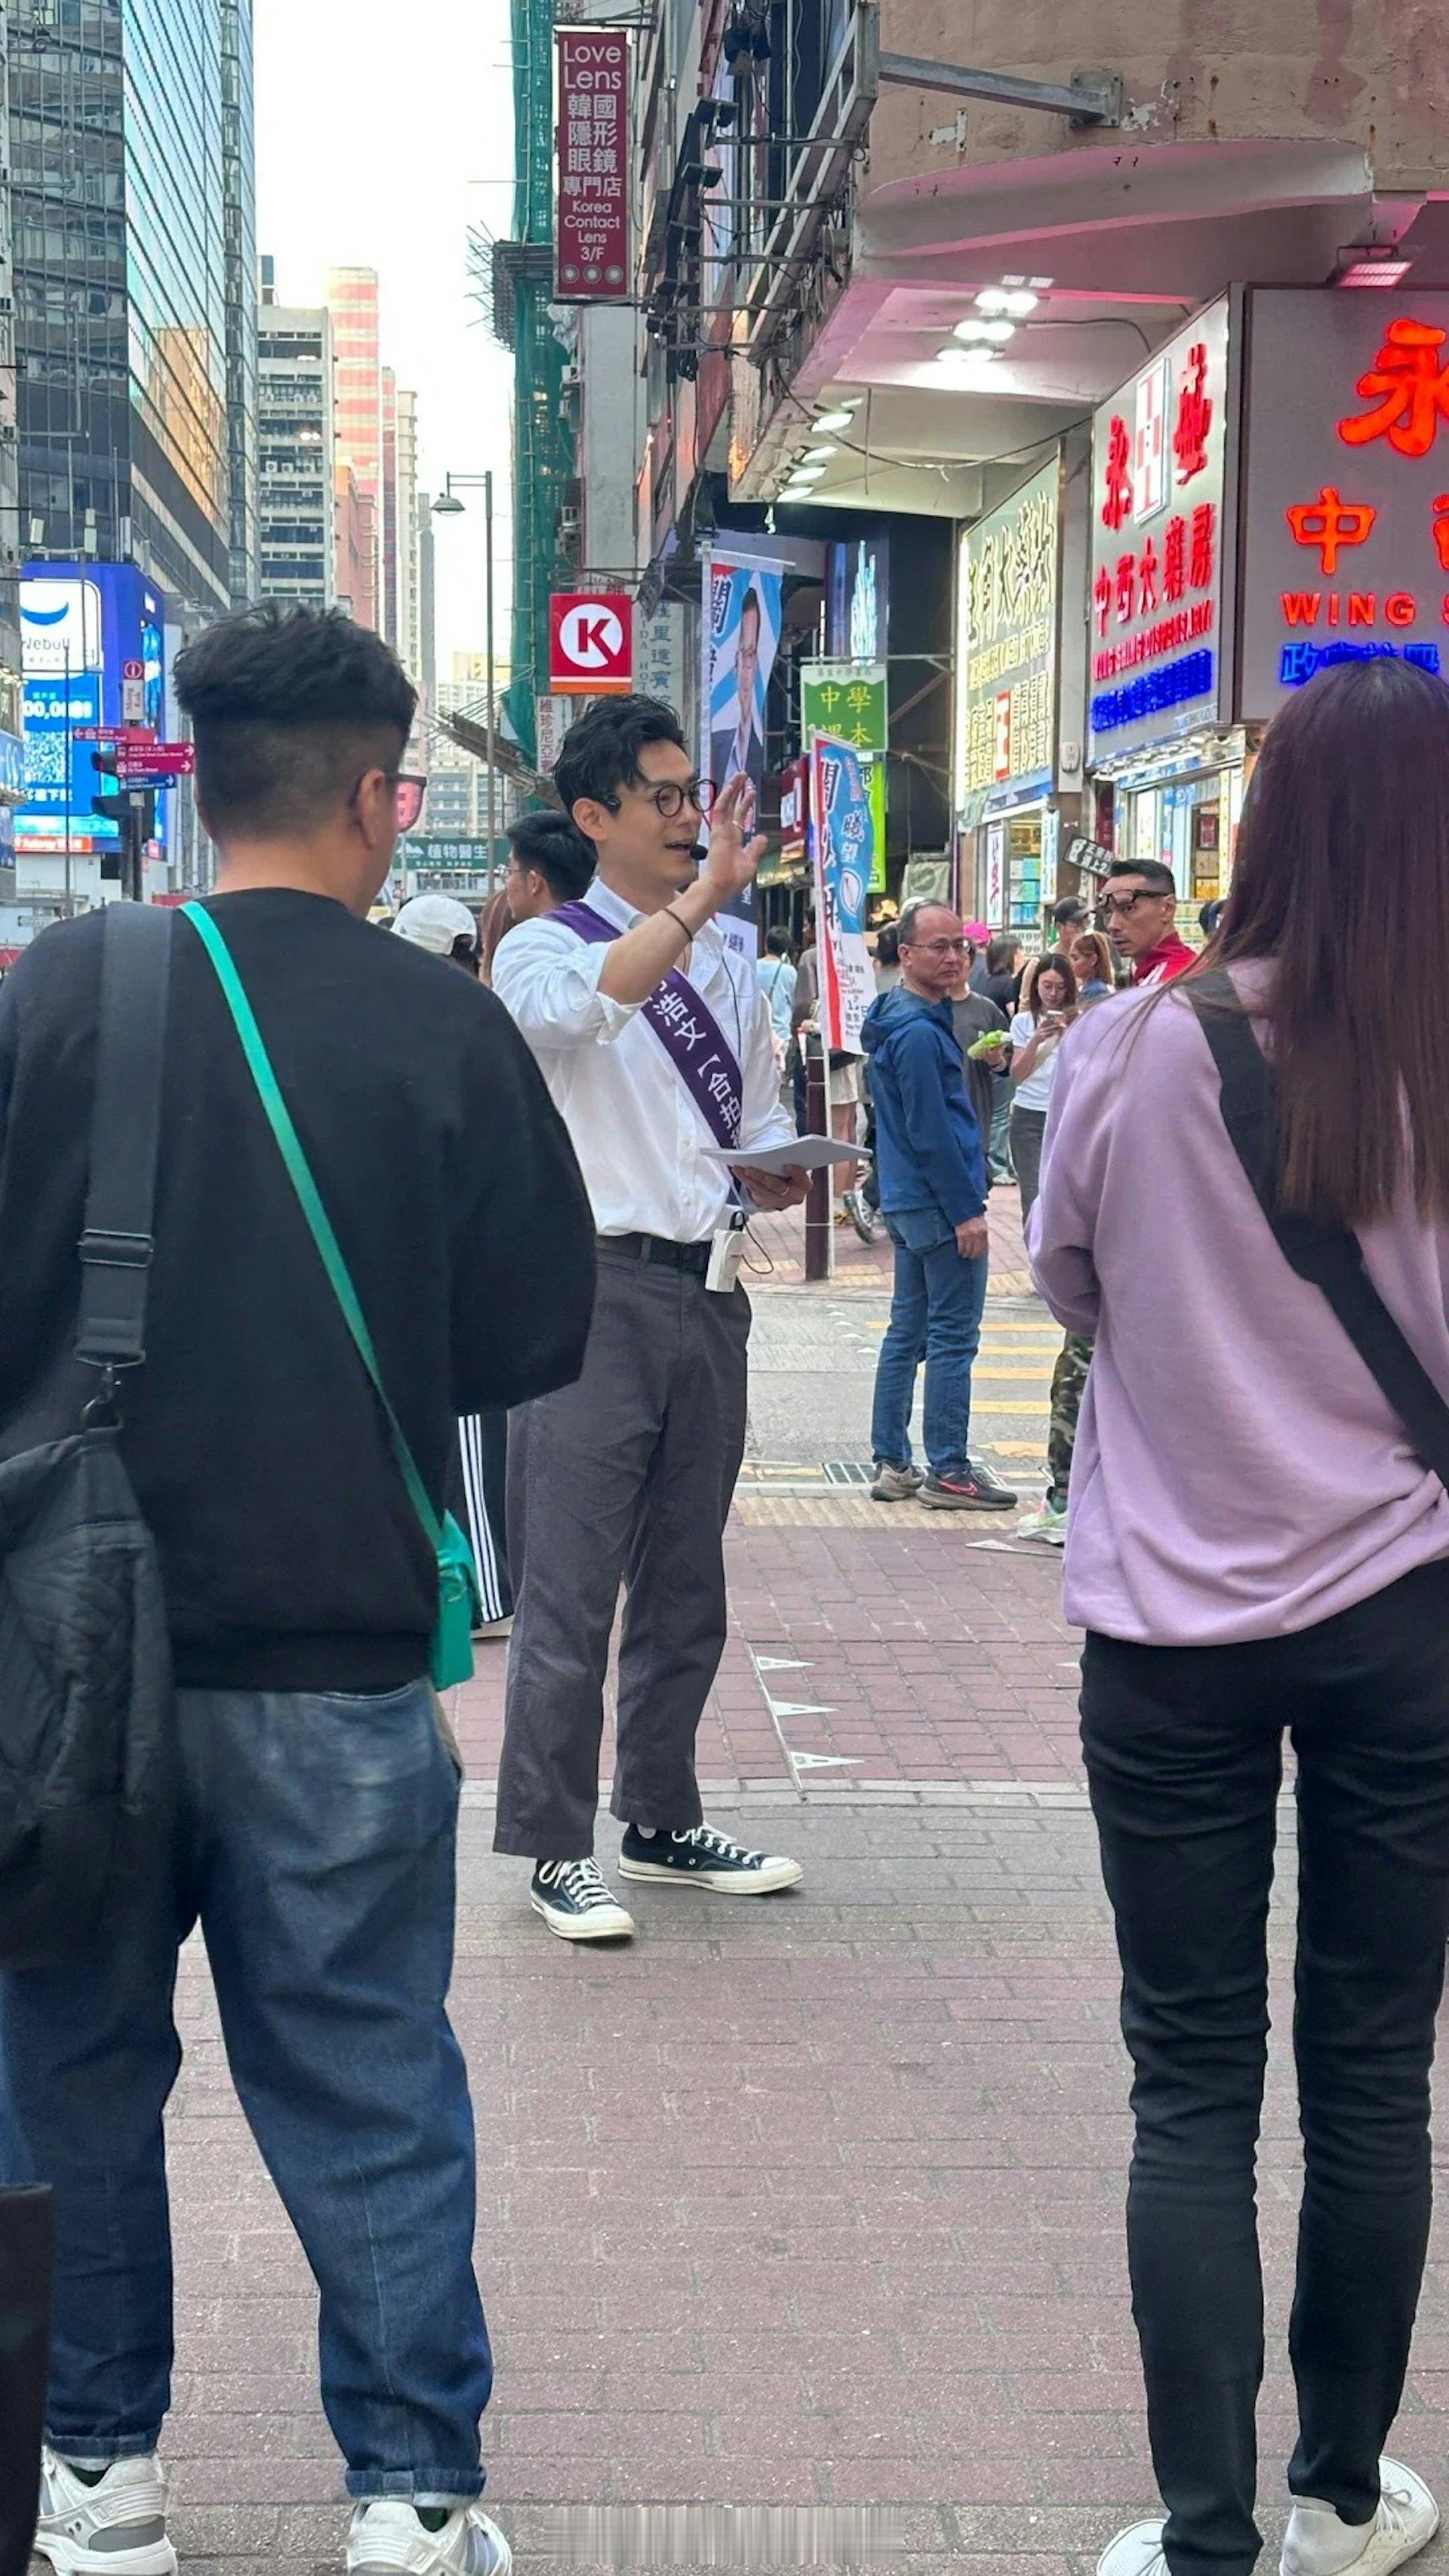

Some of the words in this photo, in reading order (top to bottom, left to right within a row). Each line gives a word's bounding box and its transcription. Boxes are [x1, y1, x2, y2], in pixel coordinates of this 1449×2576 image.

[565, 42, 622, 63] Love
[565, 66, 622, 90] Lens
[568, 94, 617, 119] 韓國
[568, 122, 617, 146] 隱形
[568, 149, 617, 174] 眼鏡
[564, 176, 622, 198] 專門店
[573, 200, 612, 214] Korea
[565, 215, 620, 229] Contact
[578, 231, 608, 244] Lens
[580, 247, 605, 261] 3/F
[1338, 318, 1449, 457] 永
[1287, 487, 1377, 576] 中
[1282, 592, 1416, 626] WING
[820, 686, 872, 713] 中學
[428, 843, 488, 860] 植物醫生
